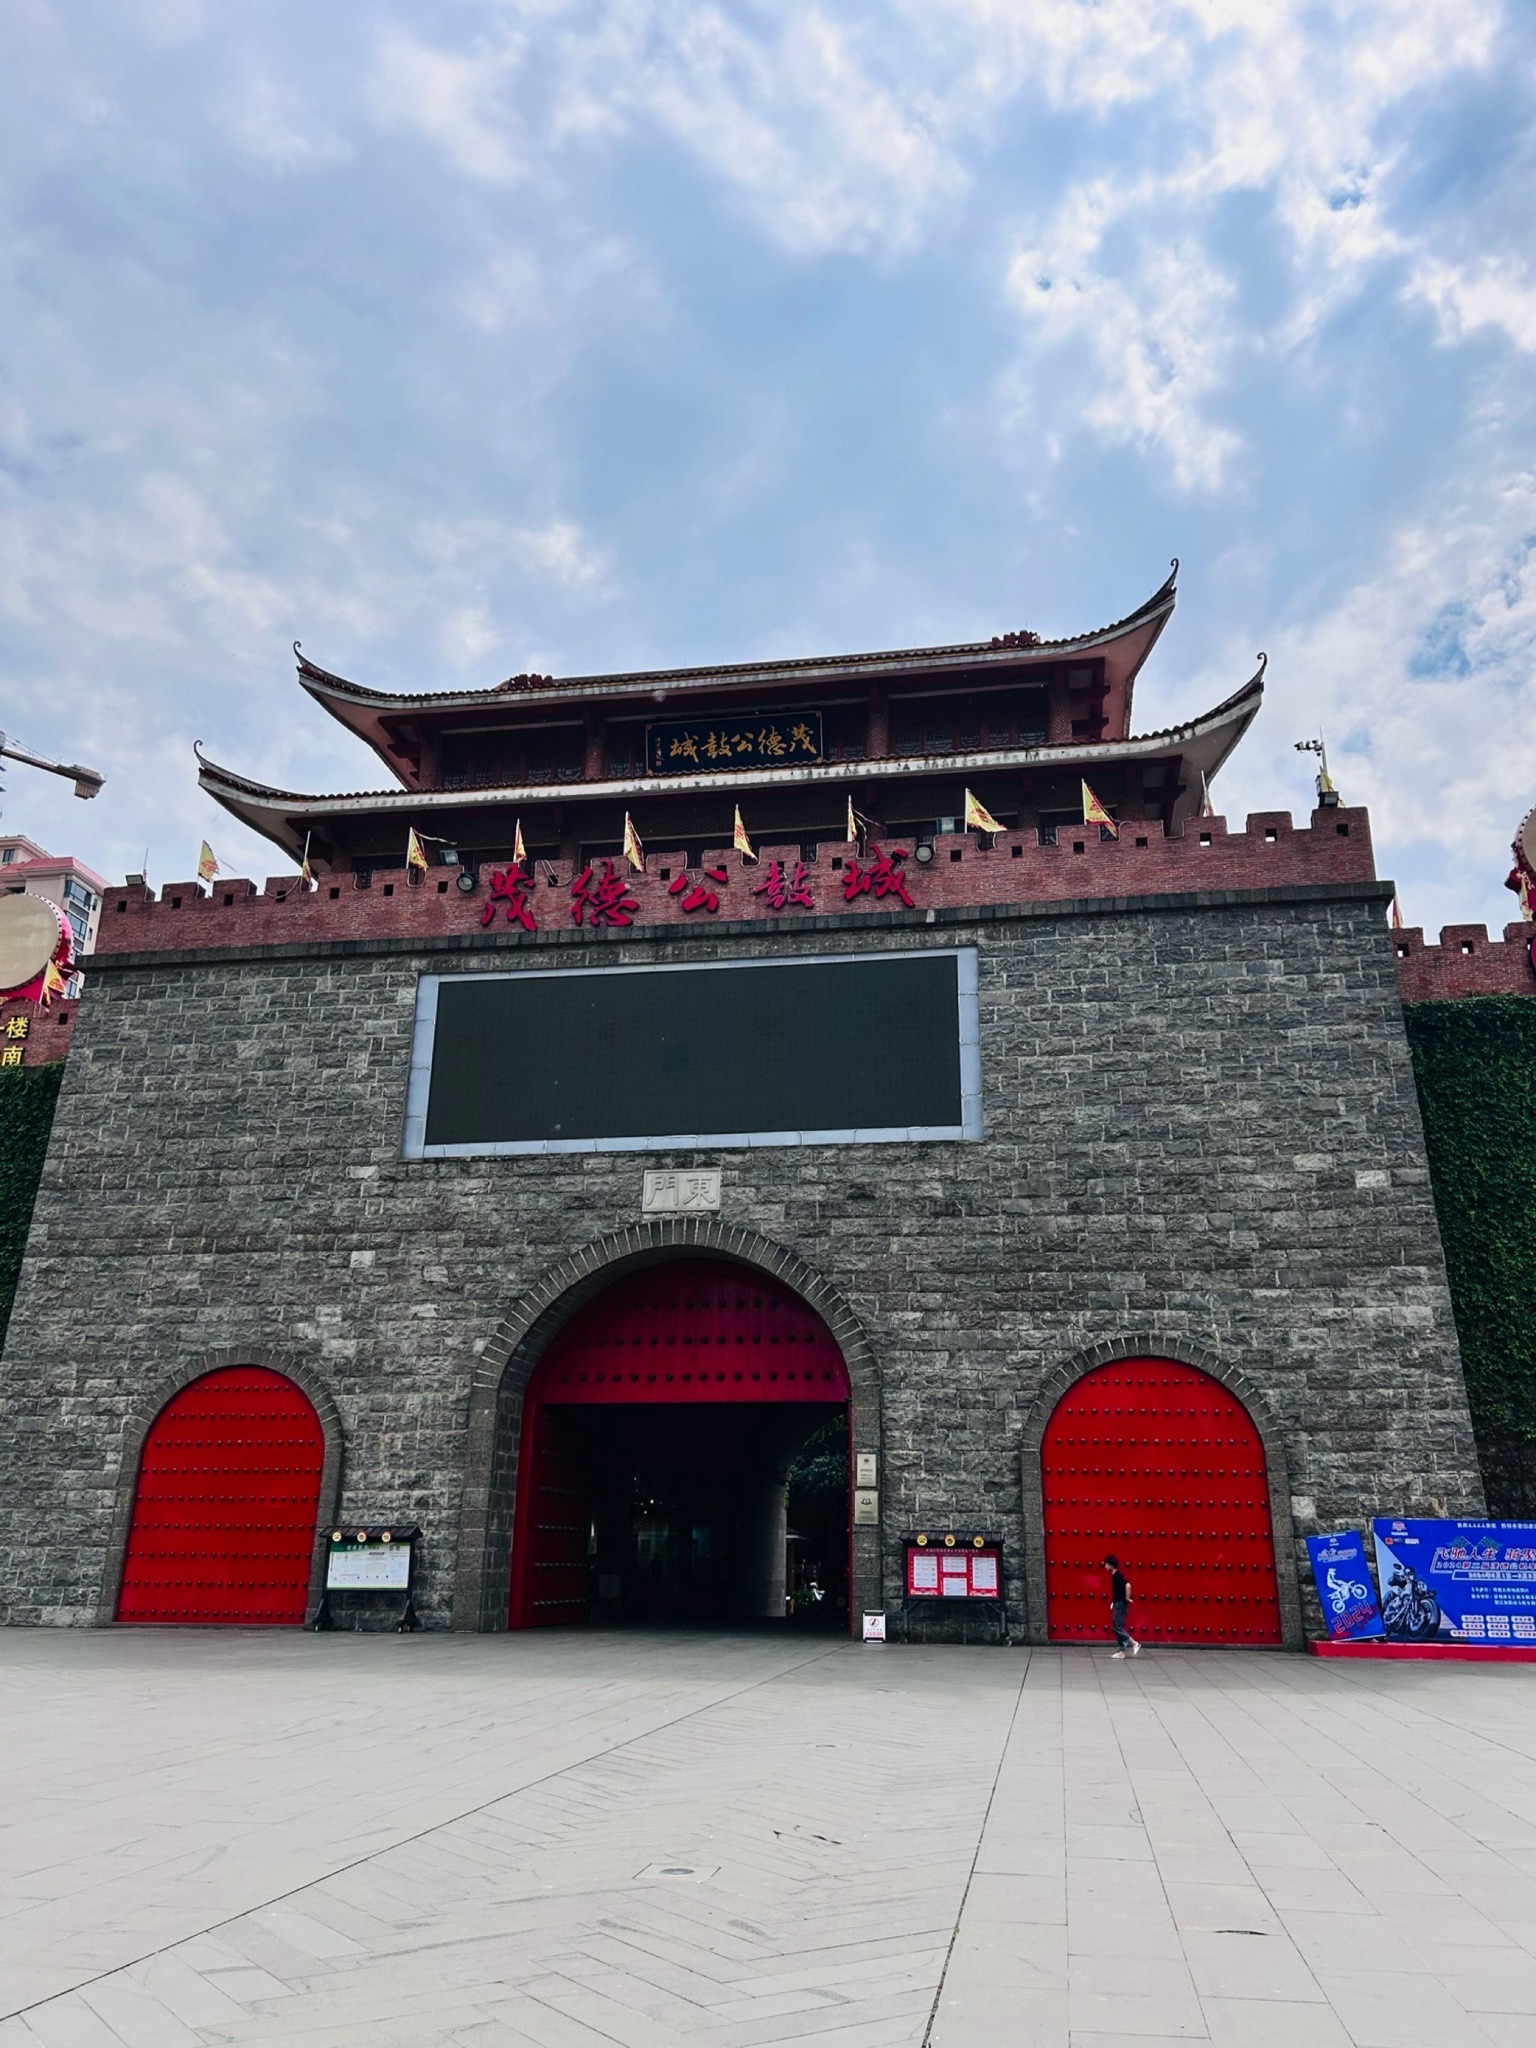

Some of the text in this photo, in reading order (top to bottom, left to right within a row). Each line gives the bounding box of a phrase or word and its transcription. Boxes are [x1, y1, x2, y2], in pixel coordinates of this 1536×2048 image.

[481, 843, 915, 932] 茂德公鼓城
[1331, 1600, 1373, 1634] 2024
